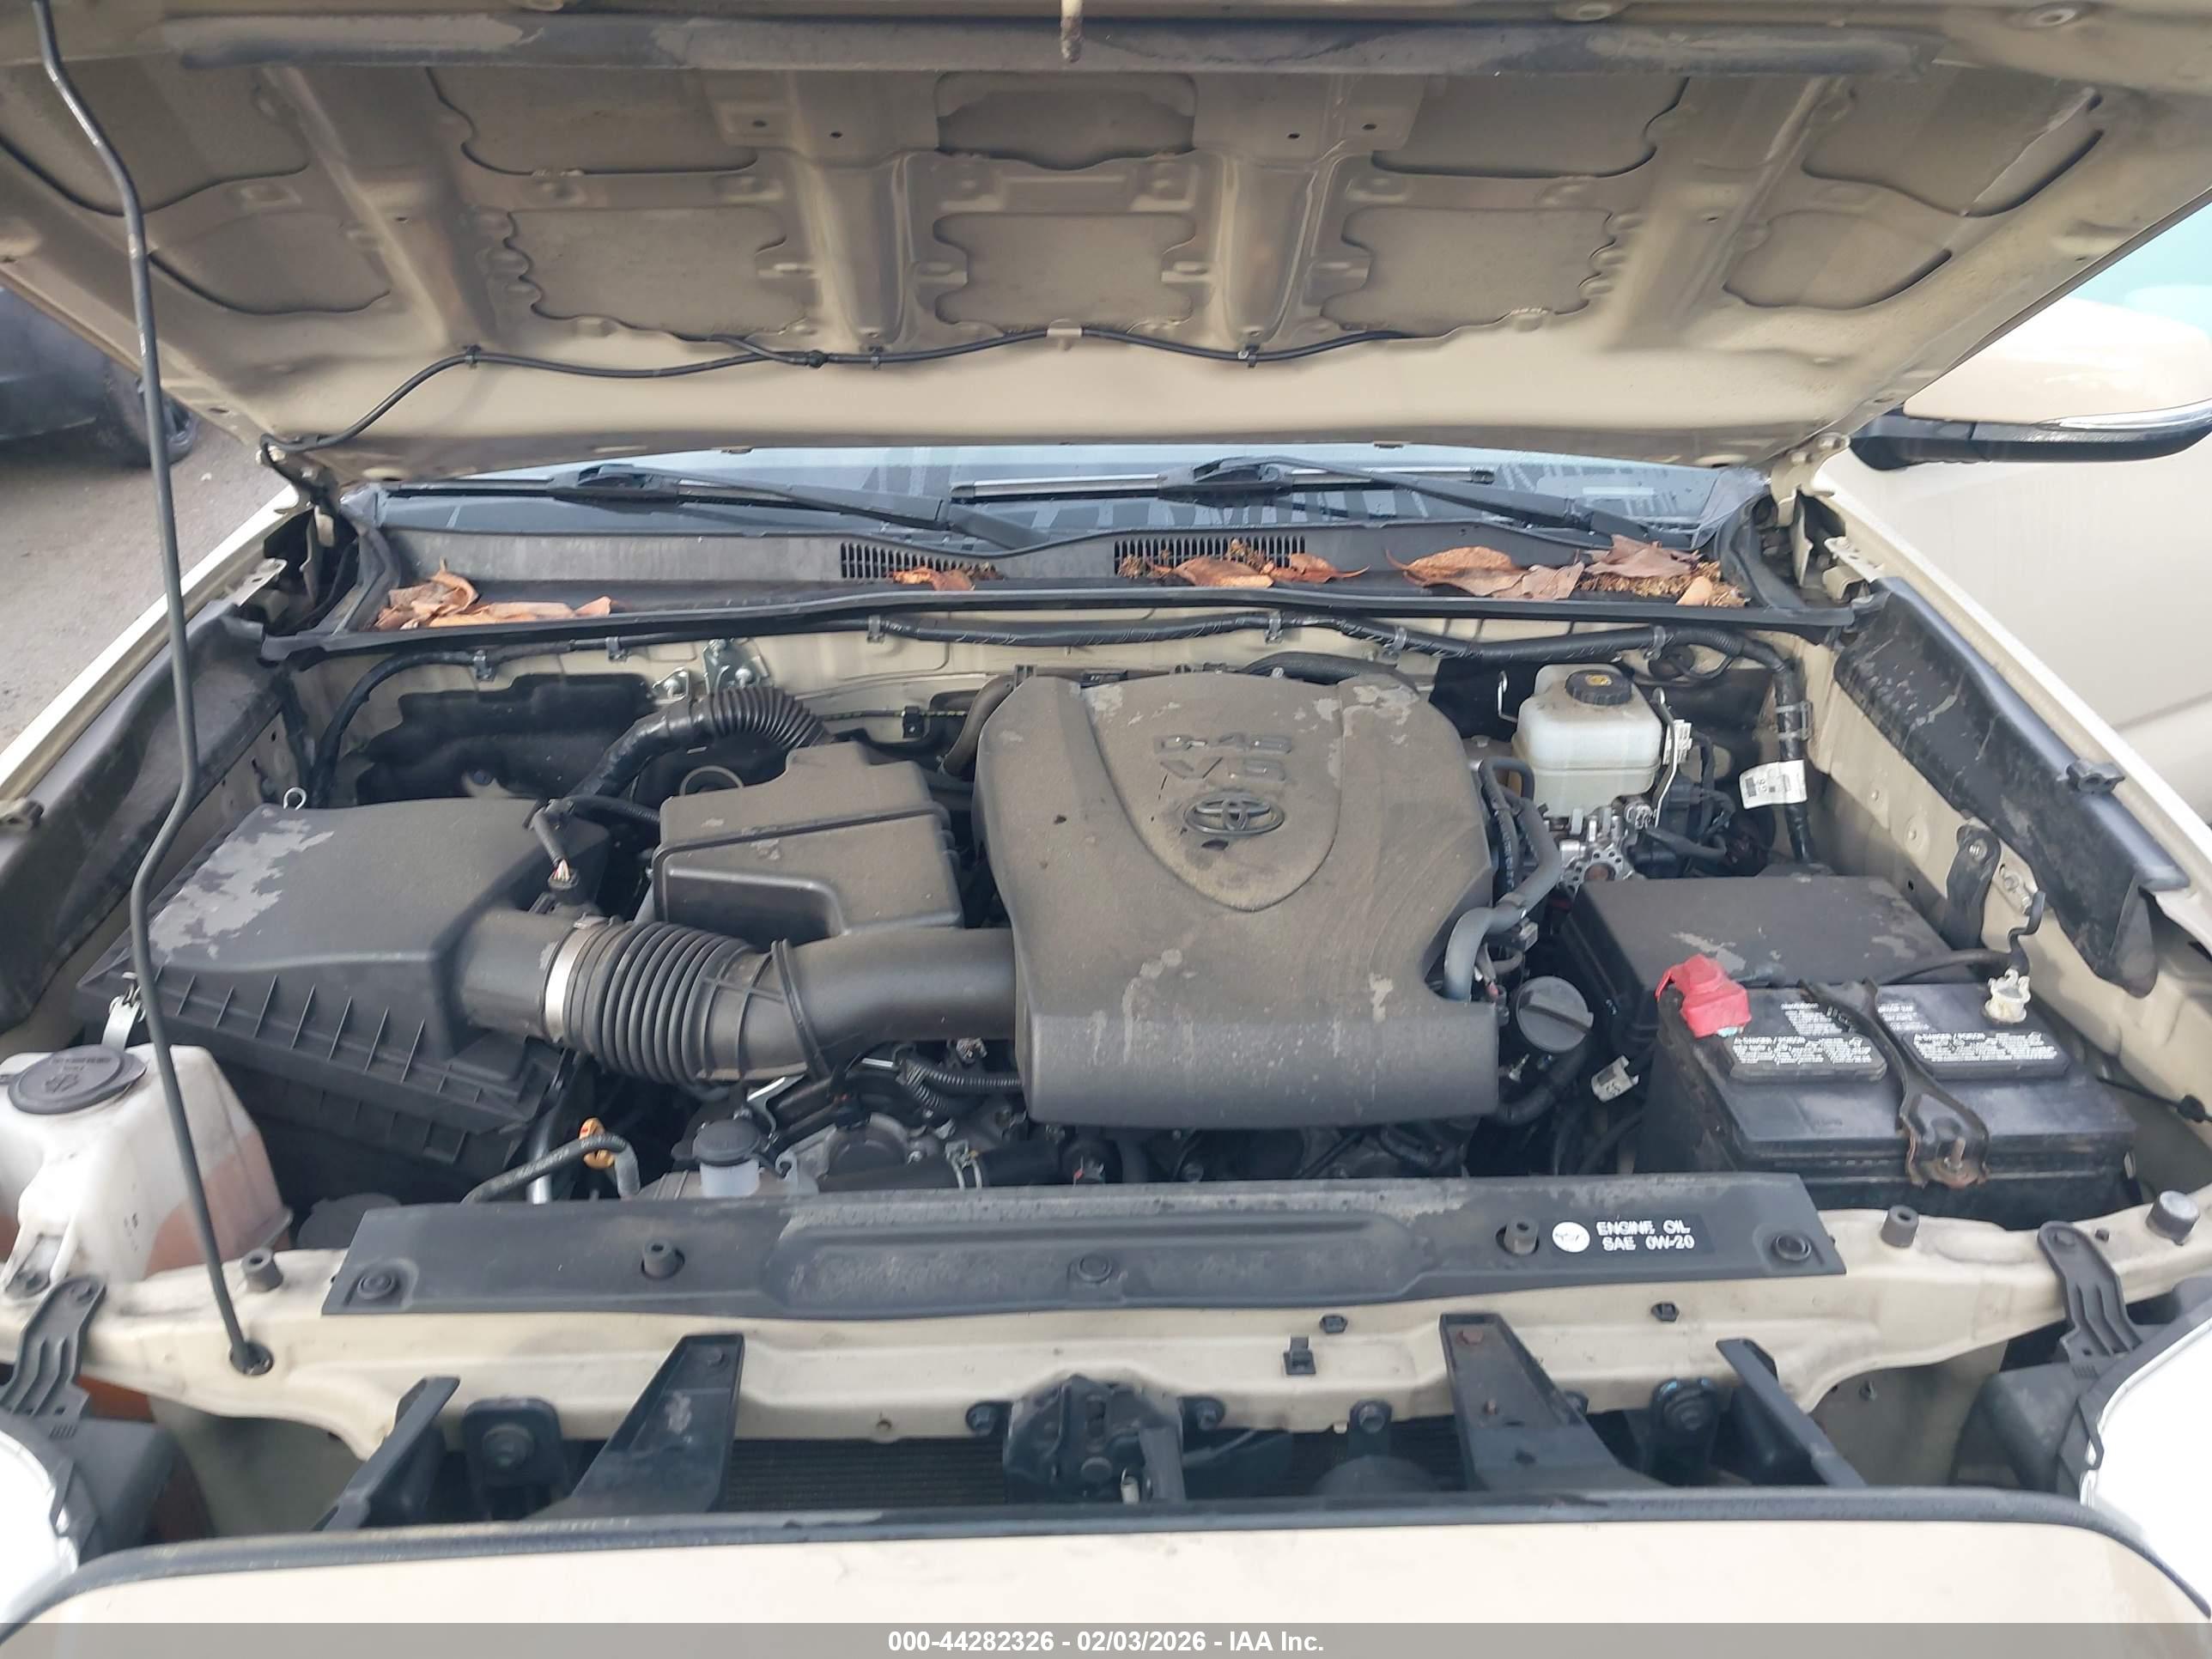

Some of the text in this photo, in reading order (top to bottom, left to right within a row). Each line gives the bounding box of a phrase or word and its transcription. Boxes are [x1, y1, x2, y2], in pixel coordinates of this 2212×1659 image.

[1595, 1219, 1691, 1236] ENGINE OIL
[1601, 1234, 1695, 1251] SAE 0W-20
